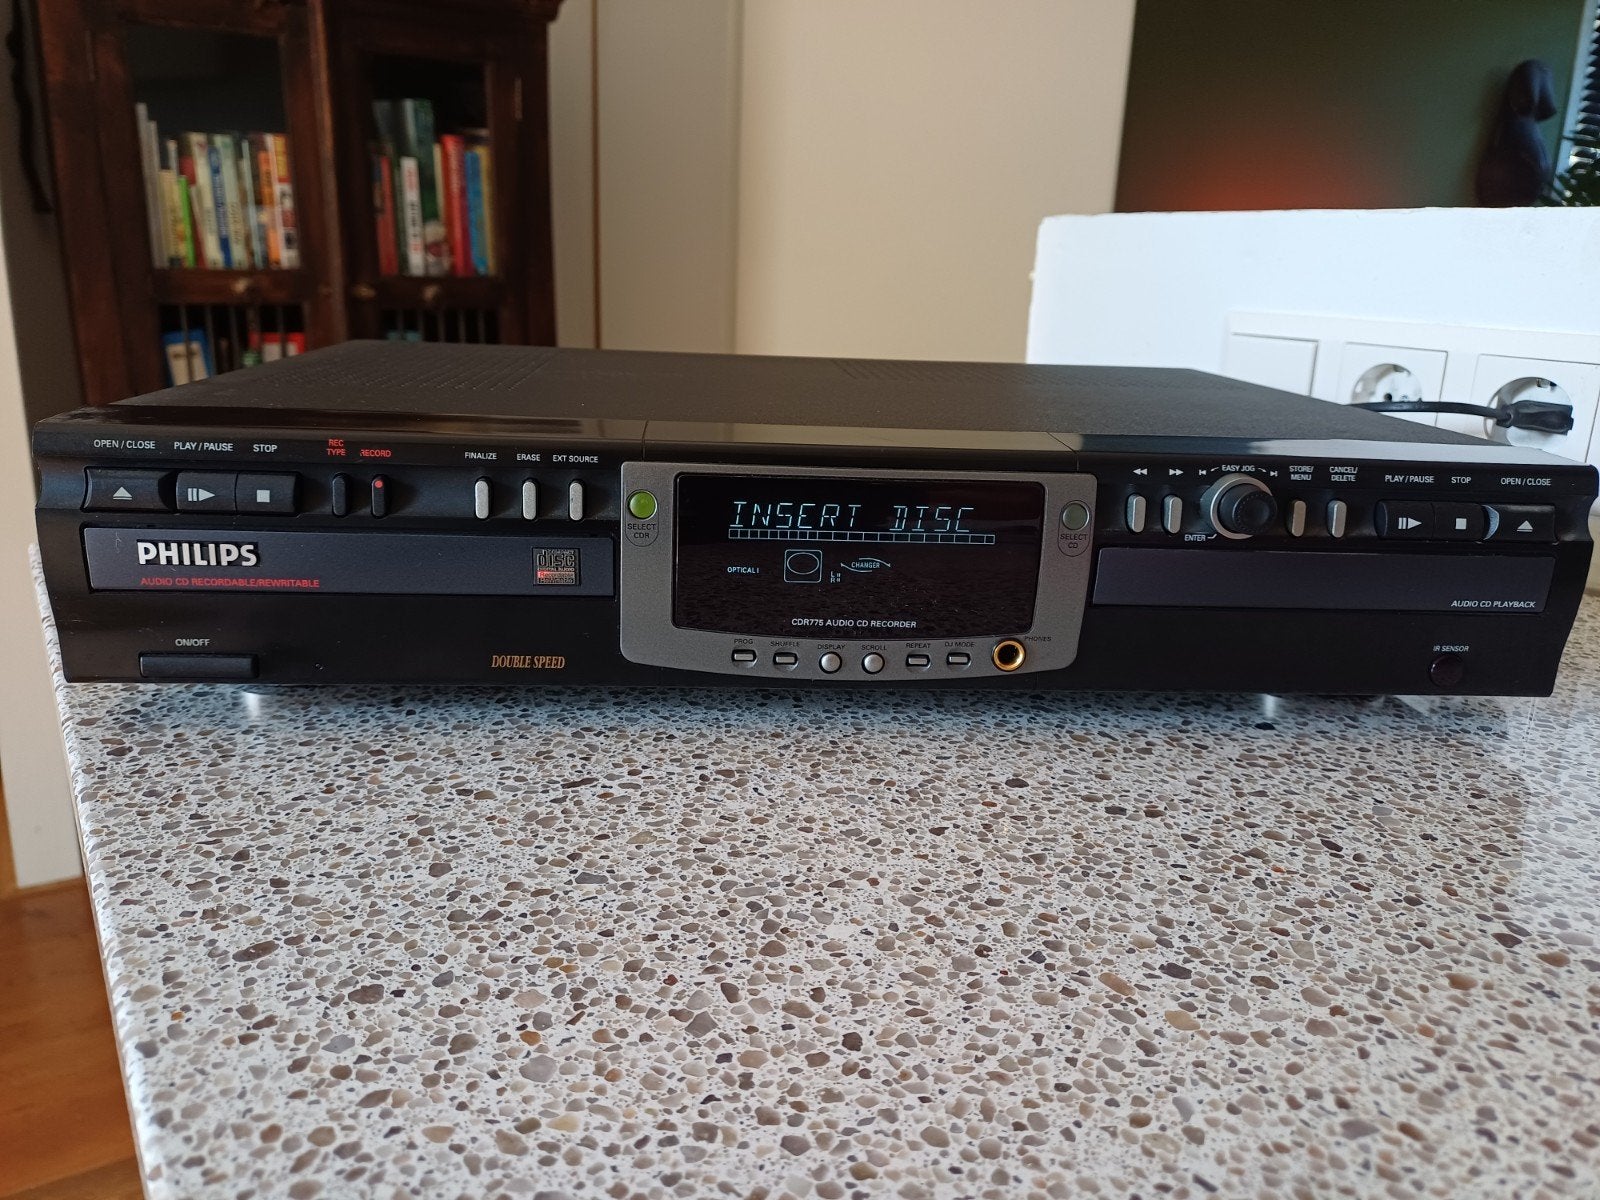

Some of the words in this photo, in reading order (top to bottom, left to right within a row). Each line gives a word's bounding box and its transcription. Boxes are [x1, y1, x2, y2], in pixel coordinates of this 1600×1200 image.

[328, 439, 344, 447] REC
[253, 444, 278, 453] STOP
[326, 448, 346, 456] TYPE
[360, 449, 392, 458] RECORD
[464, 451, 498, 460] FINALIZE
[516, 453, 541, 462] ERASE
[552, 454, 568, 463] EXT
[568, 455, 599, 464] SOURCE
[1329, 466, 1358, 474] CANCEL/
[729, 501, 862, 528] INSERT
[889, 505, 975, 532] DISC
[627, 522, 656, 531] SELECT
[1184, 534, 1206, 542] ENTER
[137, 542, 258, 567] PHILIPS
[851, 561, 880, 569] CHANGER
[140, 578, 173, 587] AUDIO
[175, 578, 190, 587] CD
[192, 578, 320, 588] RECORDABLE/REWRITABLE
[1492, 600, 1536, 608] PLAYBACK
[791, 618, 824, 626] CDR775
[826, 619, 855, 627] AUDIO
[856, 620, 869, 628] CD
[870, 620, 917, 628] RECORDER
[174, 638, 211, 647] ON/OFF
[491, 654, 532, 668] DOUBLE
[533, 656, 566, 669] SPEED
